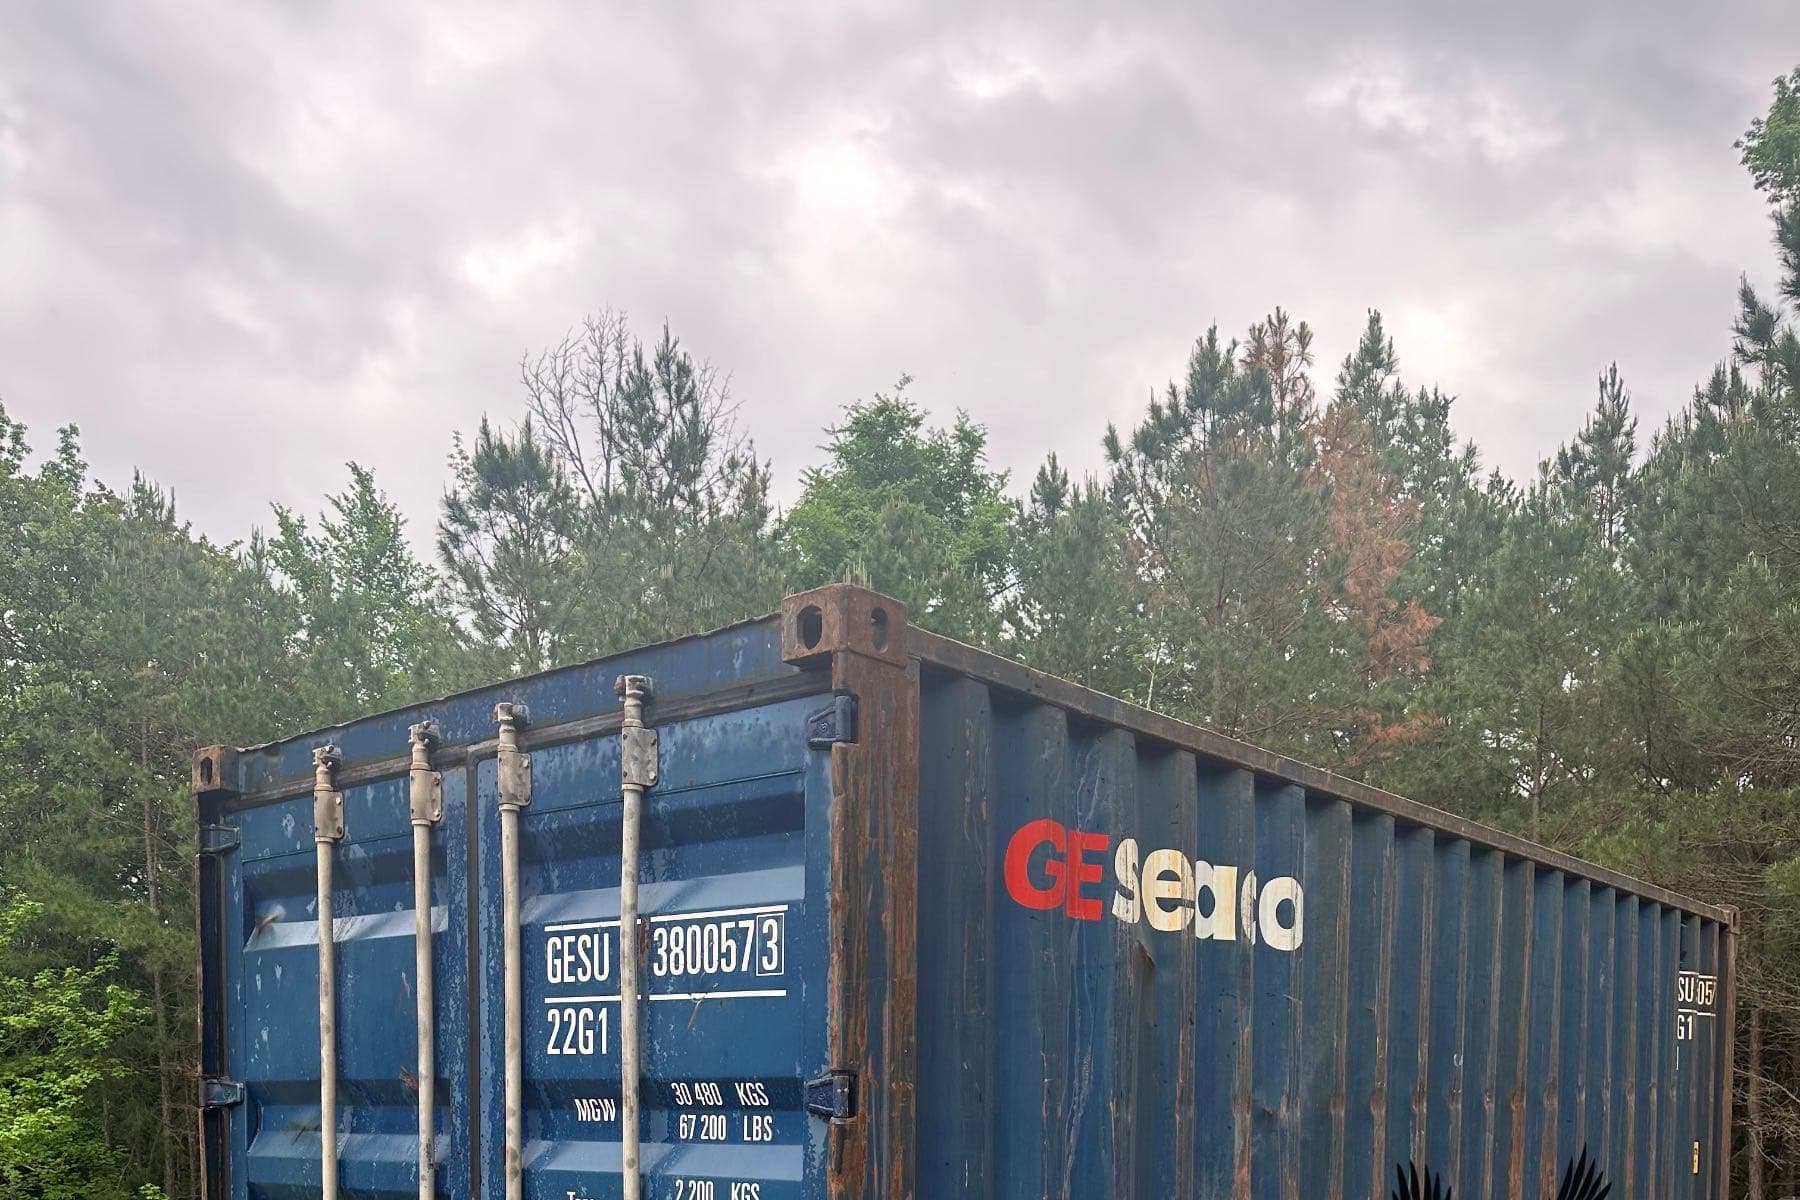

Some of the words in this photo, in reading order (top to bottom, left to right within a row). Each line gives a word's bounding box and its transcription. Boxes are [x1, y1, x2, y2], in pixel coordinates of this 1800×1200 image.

[547, 933, 610, 983] GESU
[547, 1007, 607, 1055] 22G1
[574, 1098, 616, 1122] MGW
[735, 1082, 769, 1106] KGS
[743, 1115, 773, 1141] LBS
